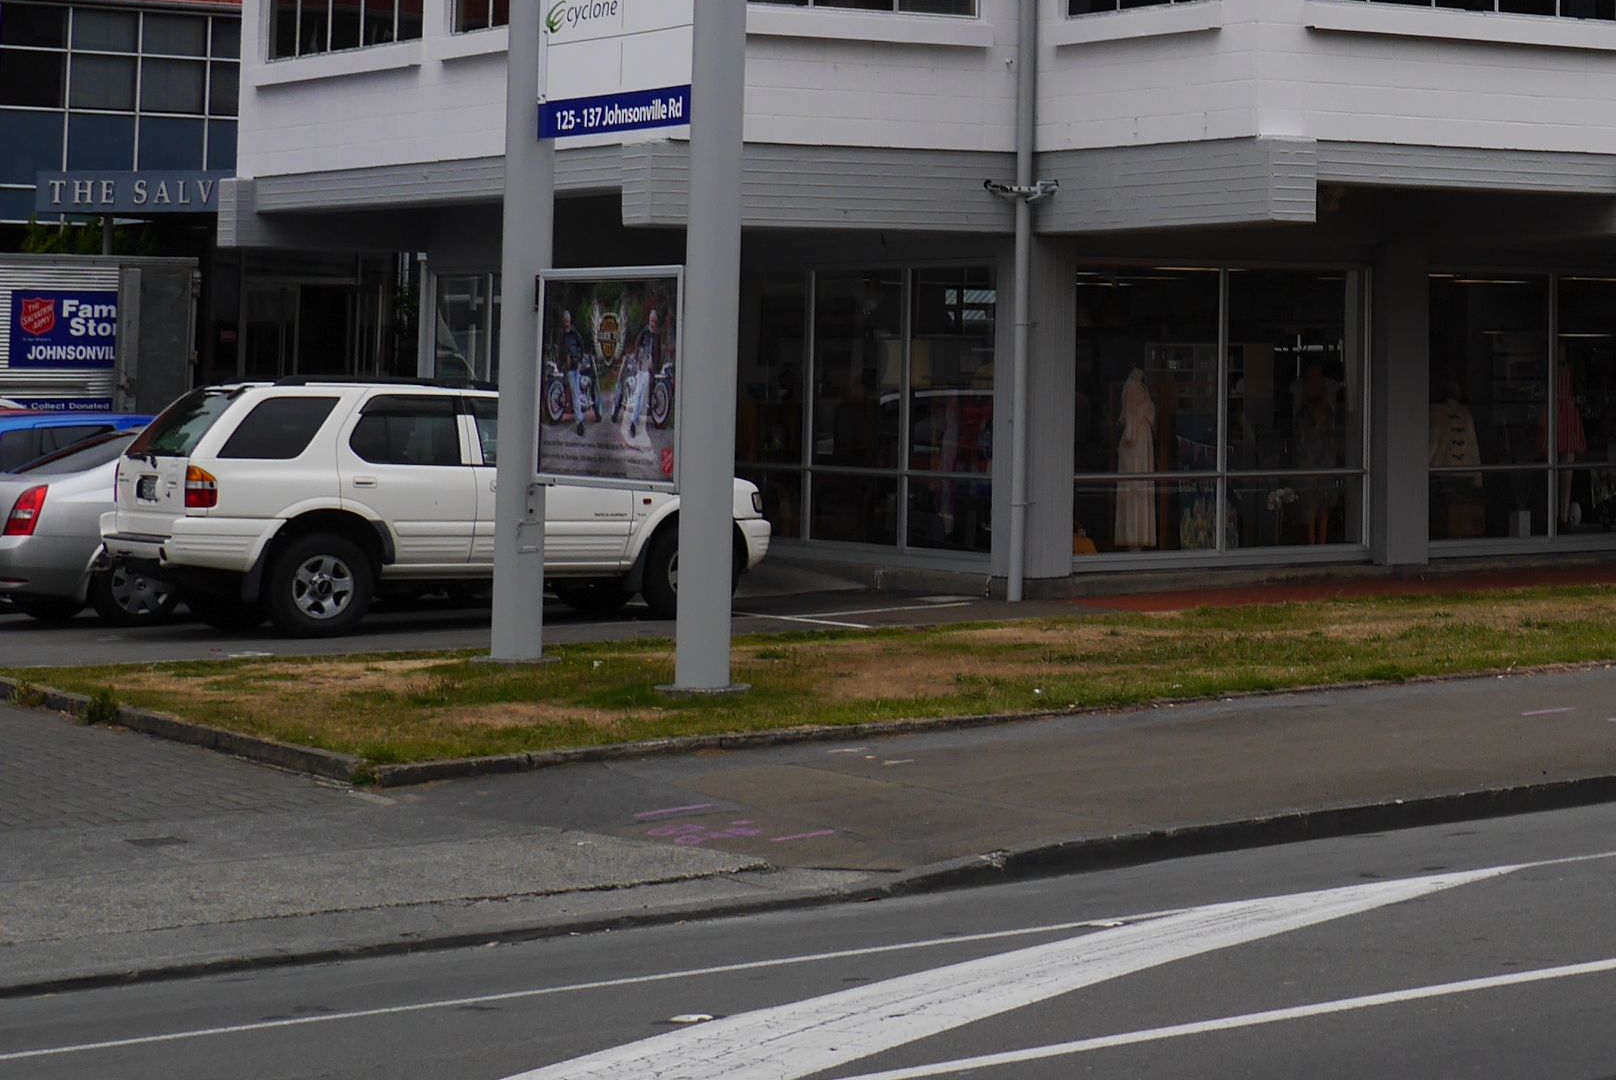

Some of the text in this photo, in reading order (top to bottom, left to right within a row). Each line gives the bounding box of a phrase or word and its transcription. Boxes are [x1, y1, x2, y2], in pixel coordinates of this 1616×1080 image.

[556, 110, 575, 130] 125
[582, 107, 602, 128] 137
[602, 98, 667, 126] Johnsonville
[668, 95, 683, 119] Rd
[49, 180, 115, 204] THE
[62, 299, 117, 318] Fam
